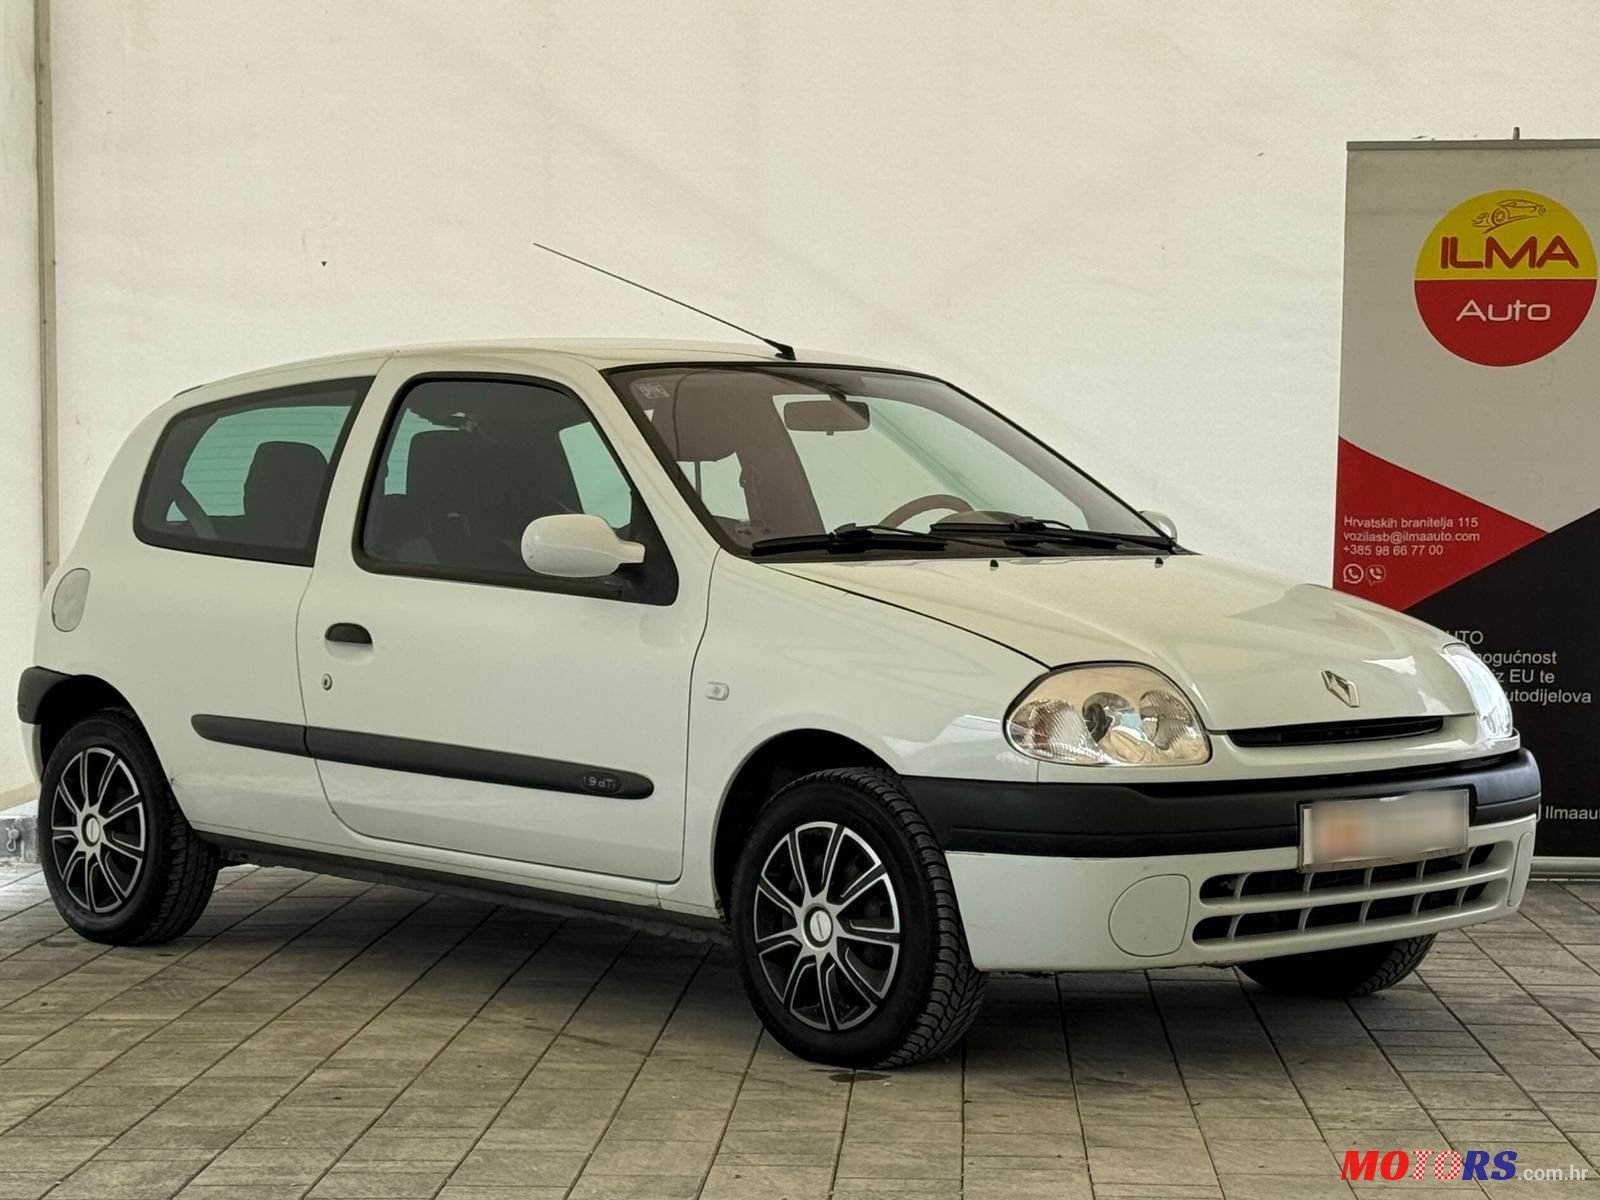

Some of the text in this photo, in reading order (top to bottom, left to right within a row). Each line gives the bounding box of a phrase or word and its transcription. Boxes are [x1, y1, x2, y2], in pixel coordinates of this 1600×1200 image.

[1440, 235, 1580, 269] ILMA
[1456, 299, 1551, 322] Auto
[1343, 515, 1479, 530] Hrvatskih branitelja 115
[1343, 531, 1480, 544] vozilasb@ilmaauto.com
[1343, 544, 1444, 556] +385 98 66 77 00
[1509, 669, 1535, 683] EU
[1539, 670, 1555, 683] te
[1545, 805, 1600, 820] Ilmaau
